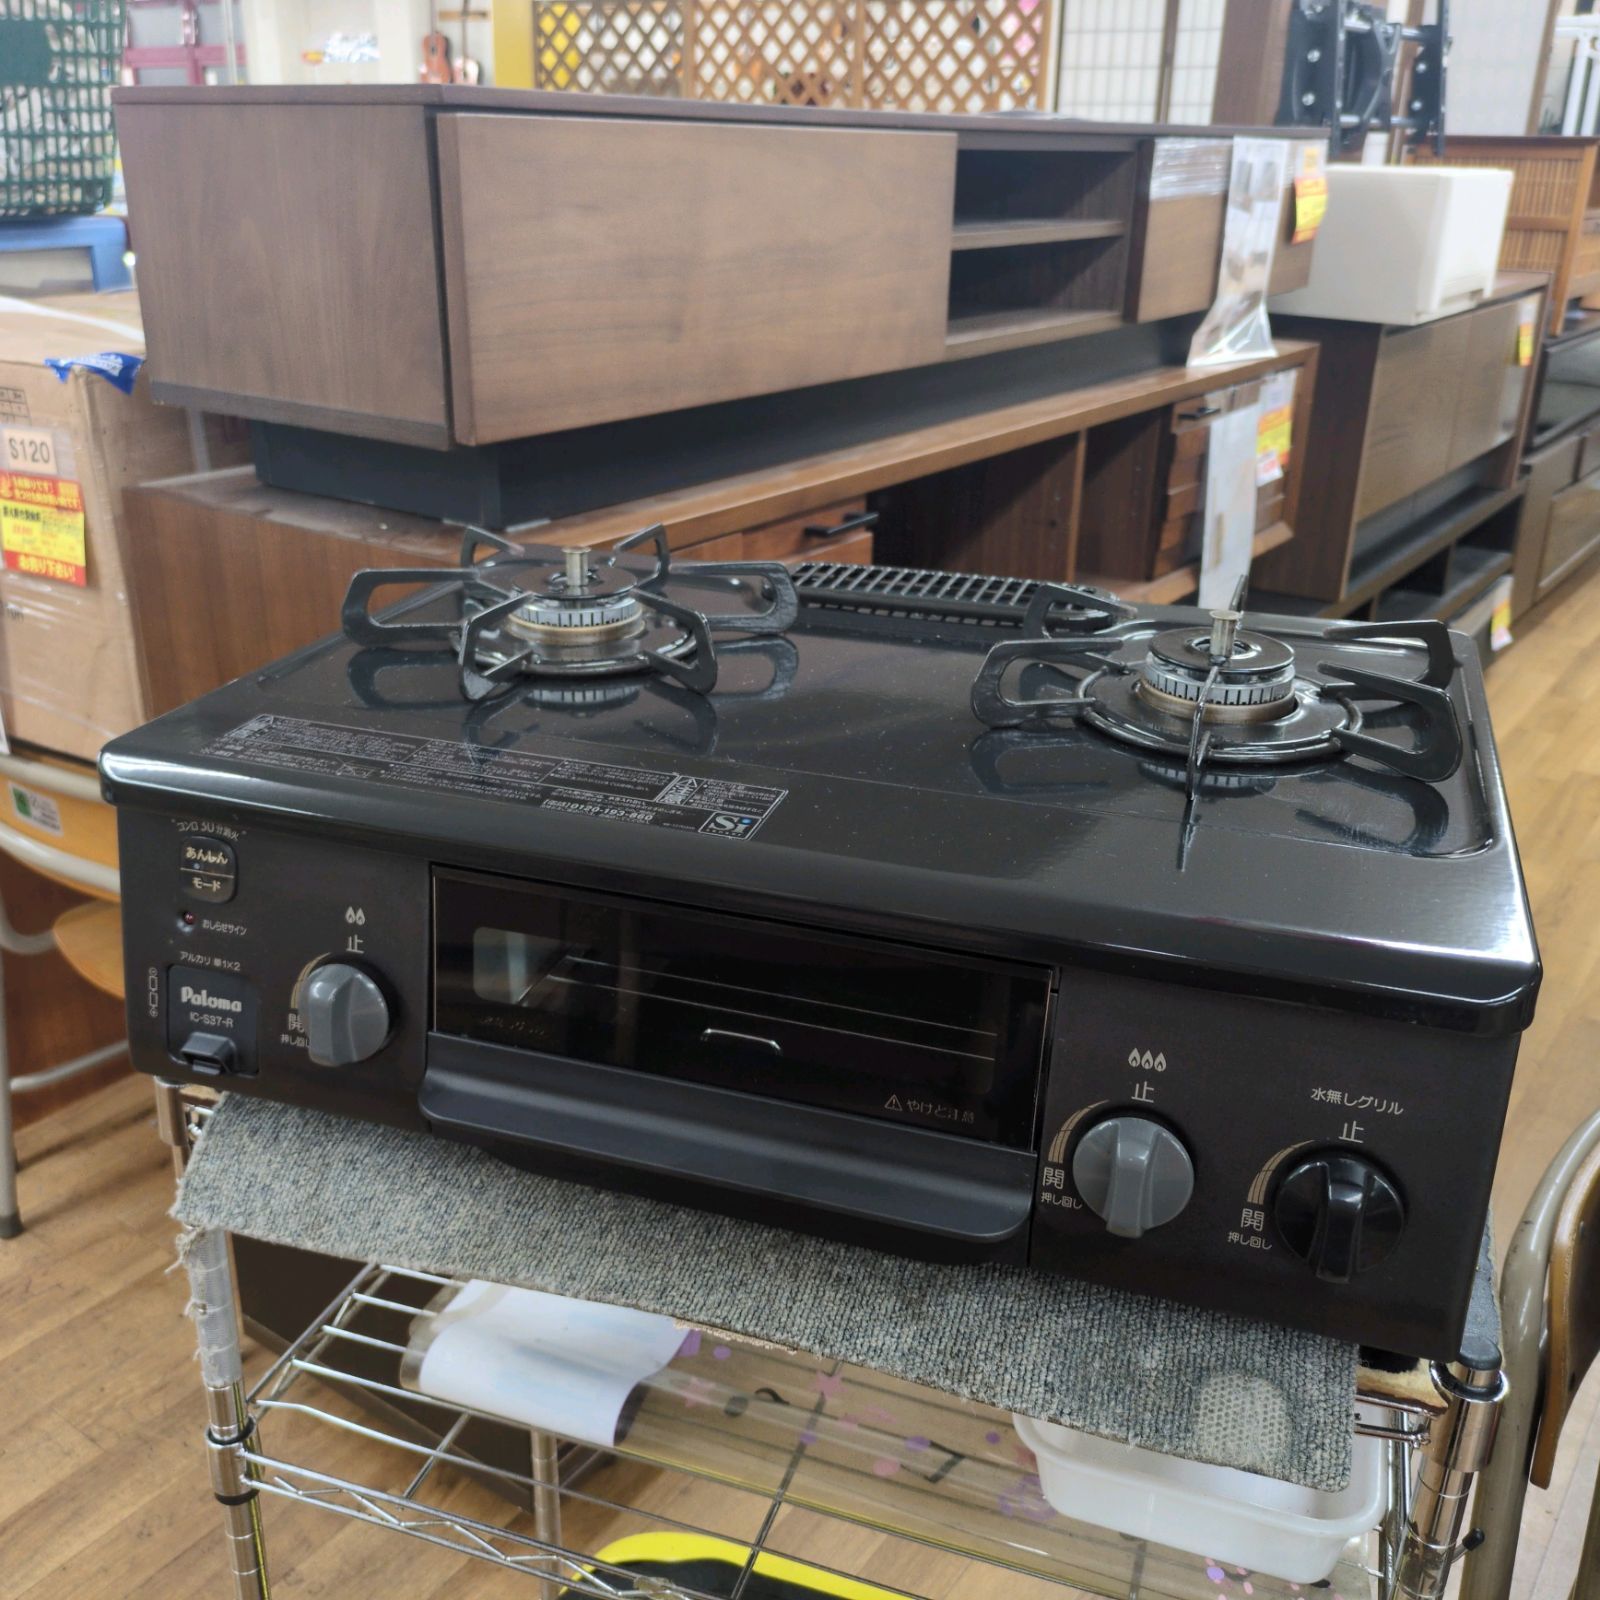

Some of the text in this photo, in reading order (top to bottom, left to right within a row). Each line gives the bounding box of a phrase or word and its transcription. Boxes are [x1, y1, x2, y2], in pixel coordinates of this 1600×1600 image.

[8, 437, 51, 465] S120
[185, 846, 228, 865] あんしん
[192, 876, 221, 892] モード
[345, 933, 364, 954] 止
[179, 950, 211, 965] アルカリ
[180, 985, 242, 1012] Paloma
[189, 1011, 234, 1028] IC-S37-R
[1130, 1080, 1154, 1104] 止
[1310, 1086, 1404, 1117] 水無しグリル
[1338, 1120, 1365, 1144] 止
[1042, 1166, 1065, 1190] 開
[1040, 1191, 1083, 1210] 押し回し
[1240, 1208, 1265, 1232] 開
[1227, 1231, 1272, 1251] 押し回し
